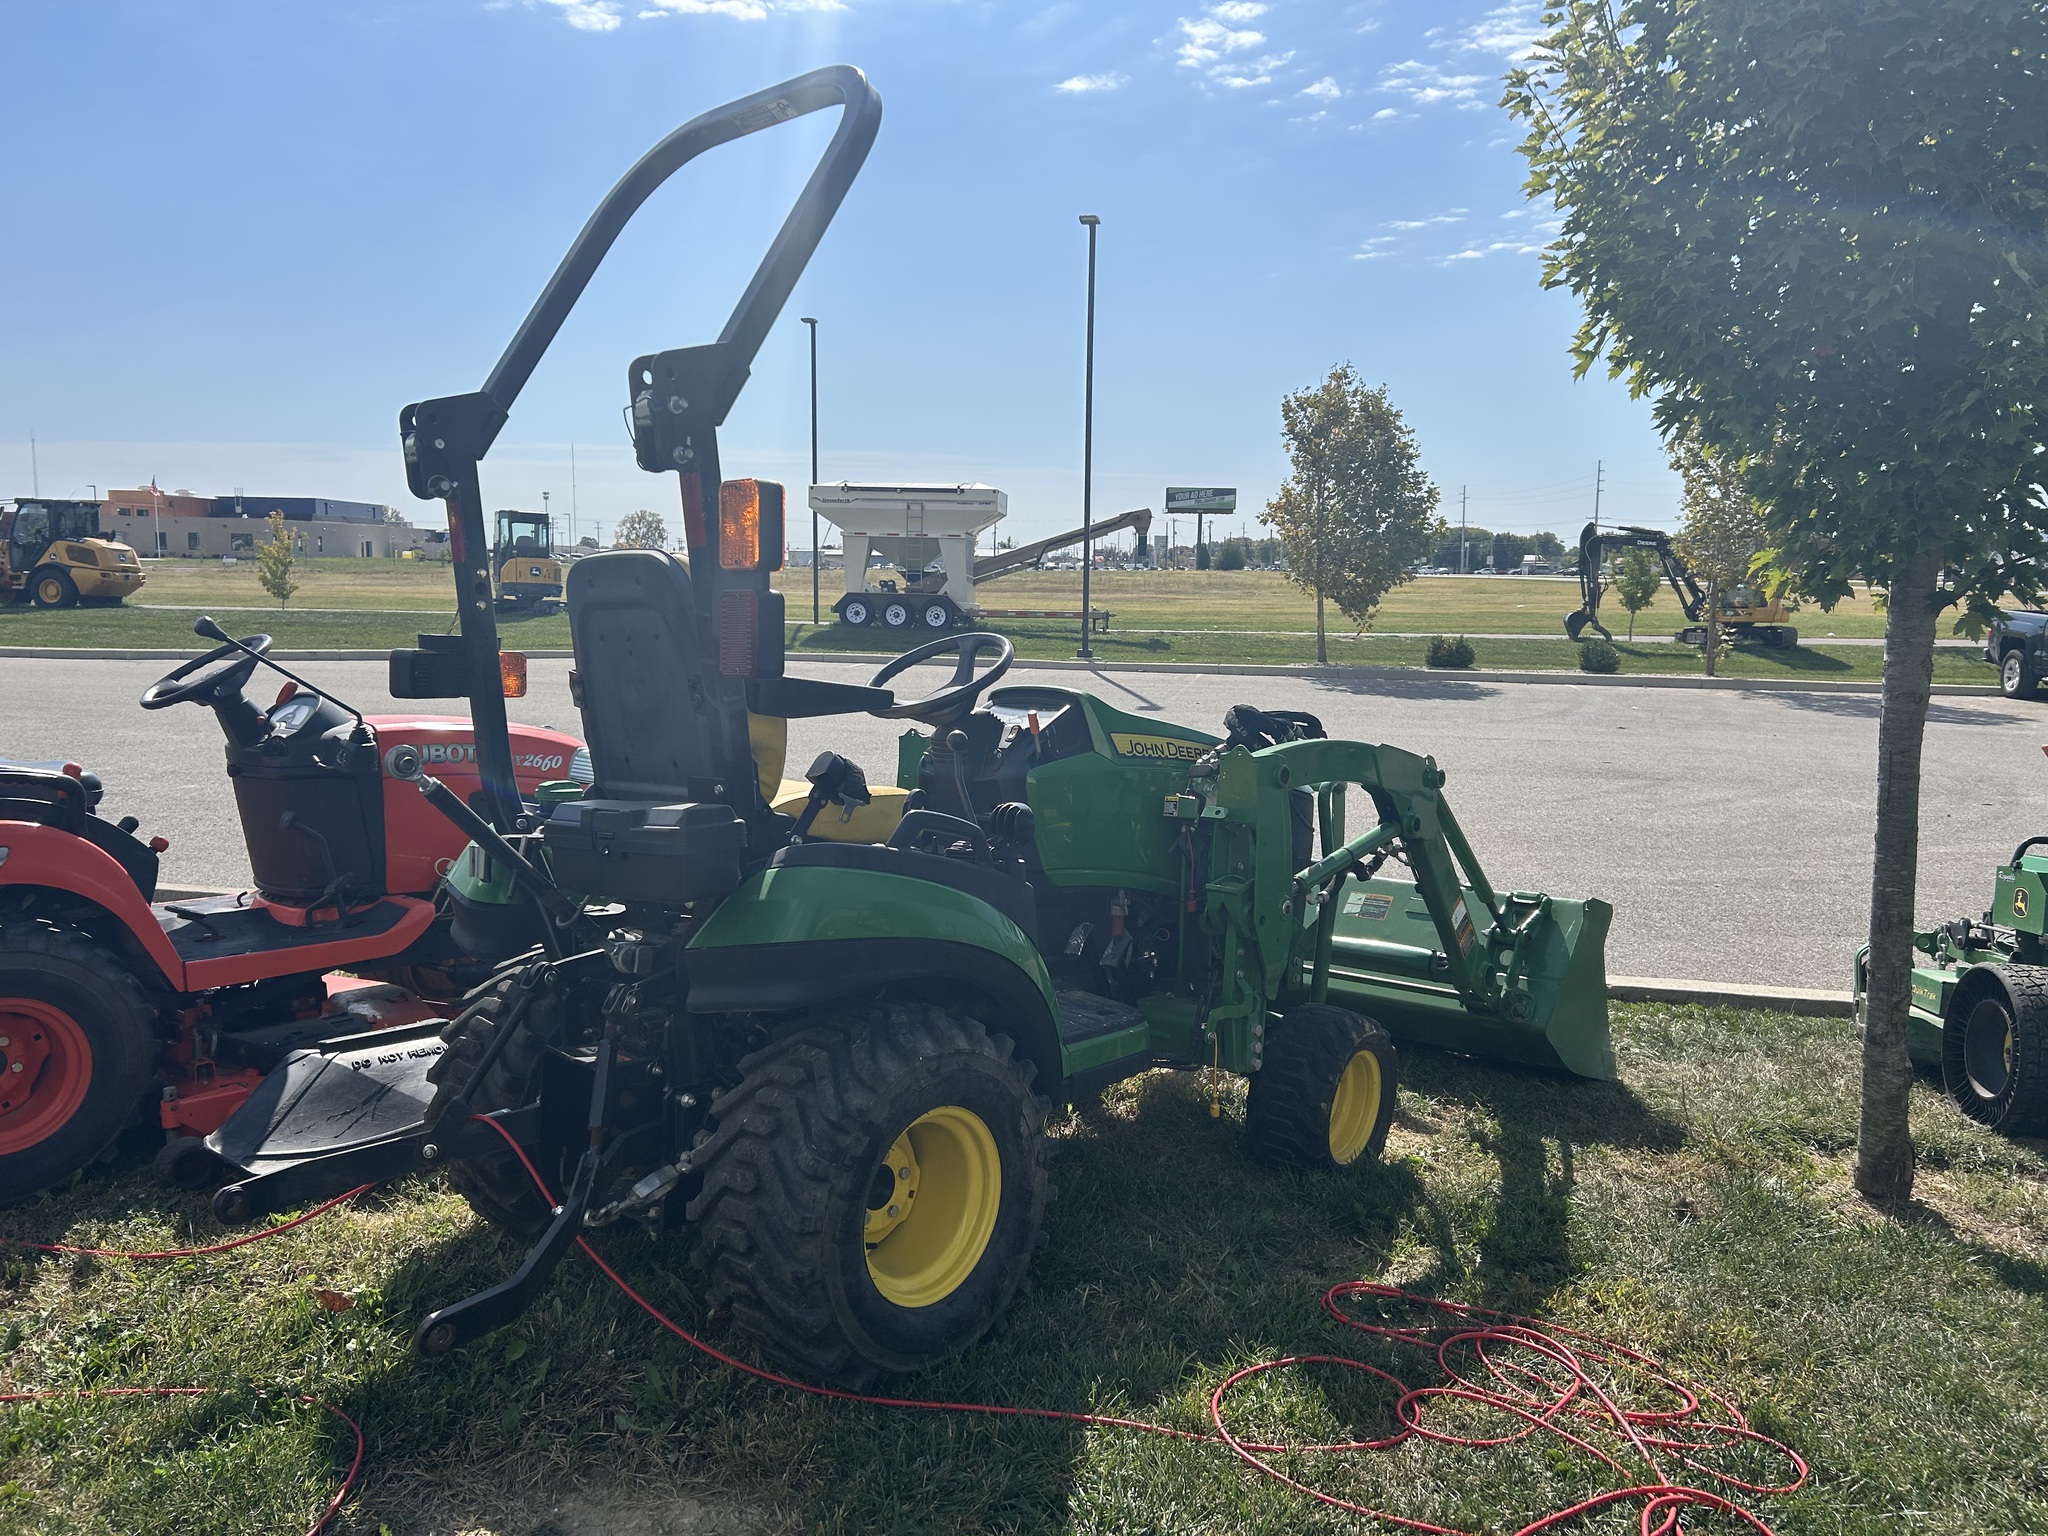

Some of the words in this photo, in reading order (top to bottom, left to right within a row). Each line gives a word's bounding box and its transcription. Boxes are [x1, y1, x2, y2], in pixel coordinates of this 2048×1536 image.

[1174, 491, 1190, 501] YOUR
[1190, 491, 1198, 499] AD
[1199, 489, 1214, 498] HERE
[413, 743, 478, 764] UBOT
[1126, 739, 1165, 756] JOHN
[512, 754, 563, 771] X2660
[351, 1059, 372, 1072] DO
[377, 1052, 403, 1065] NOT
[407, 1044, 449, 1060] REMOV
